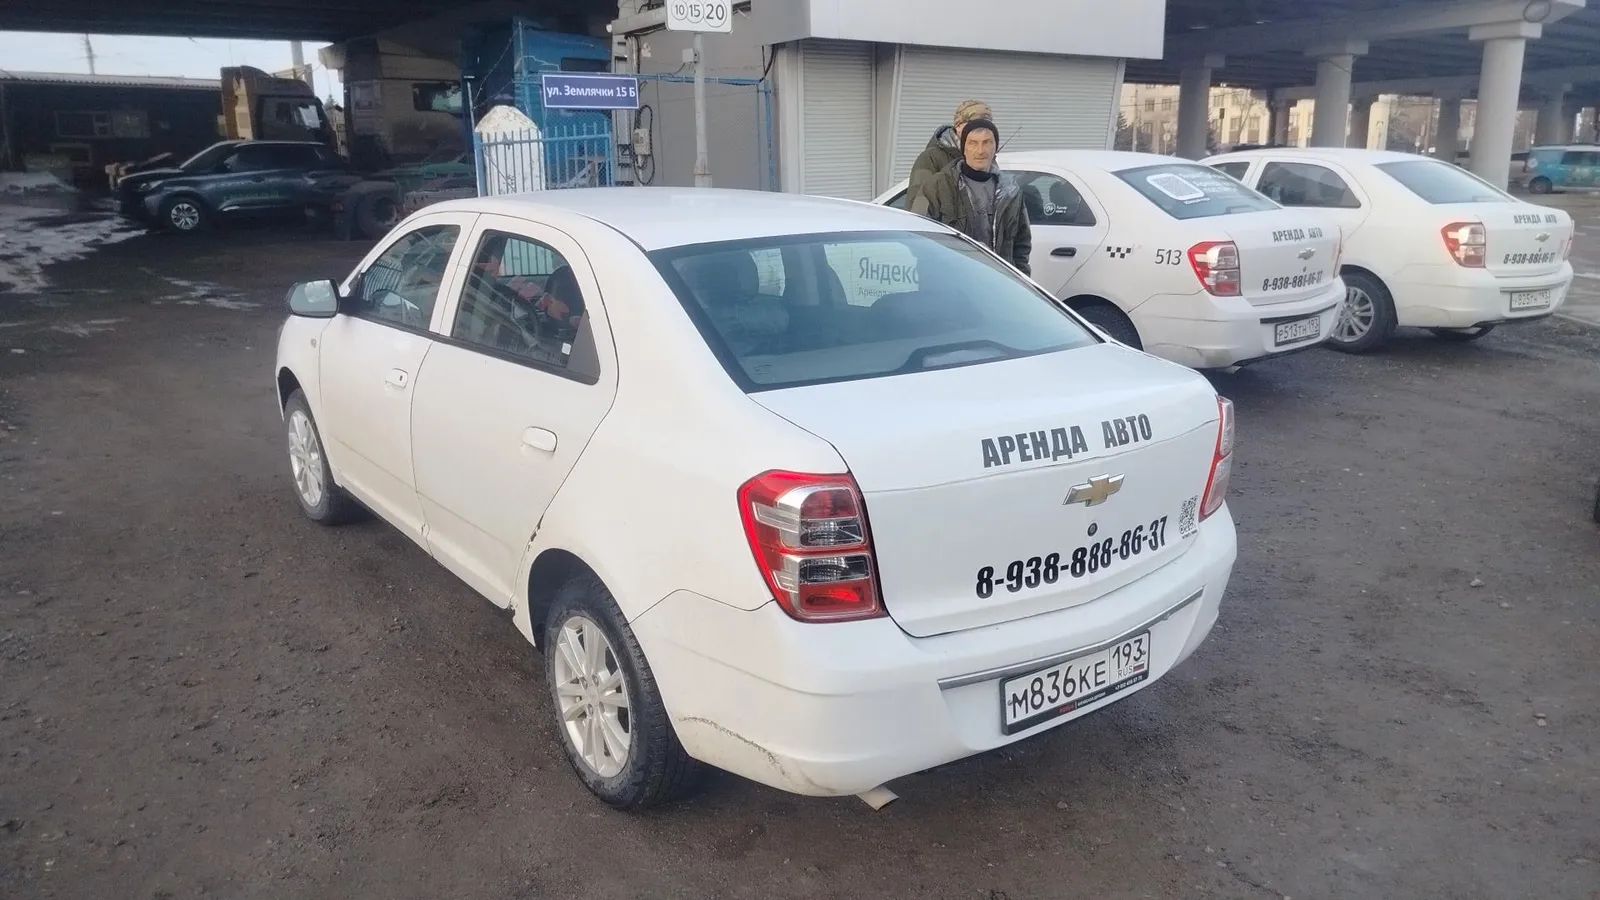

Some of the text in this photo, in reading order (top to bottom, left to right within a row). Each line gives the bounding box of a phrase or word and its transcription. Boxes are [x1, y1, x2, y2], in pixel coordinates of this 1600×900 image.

[675, 3, 725, 21] 10 15 20
[546, 85, 636, 98] ул. Землячки 15 Б
[1272, 228, 1306, 243] АРЕНДА
[1155, 248, 1182, 266] 513
[981, 413, 1153, 469] АРЕНДА АВТО
[976, 515, 1168, 599] 8-938-888-86-37
[1011, 638, 1143, 719] М836КЕ 193
[1117, 664, 1134, 679] RUS
